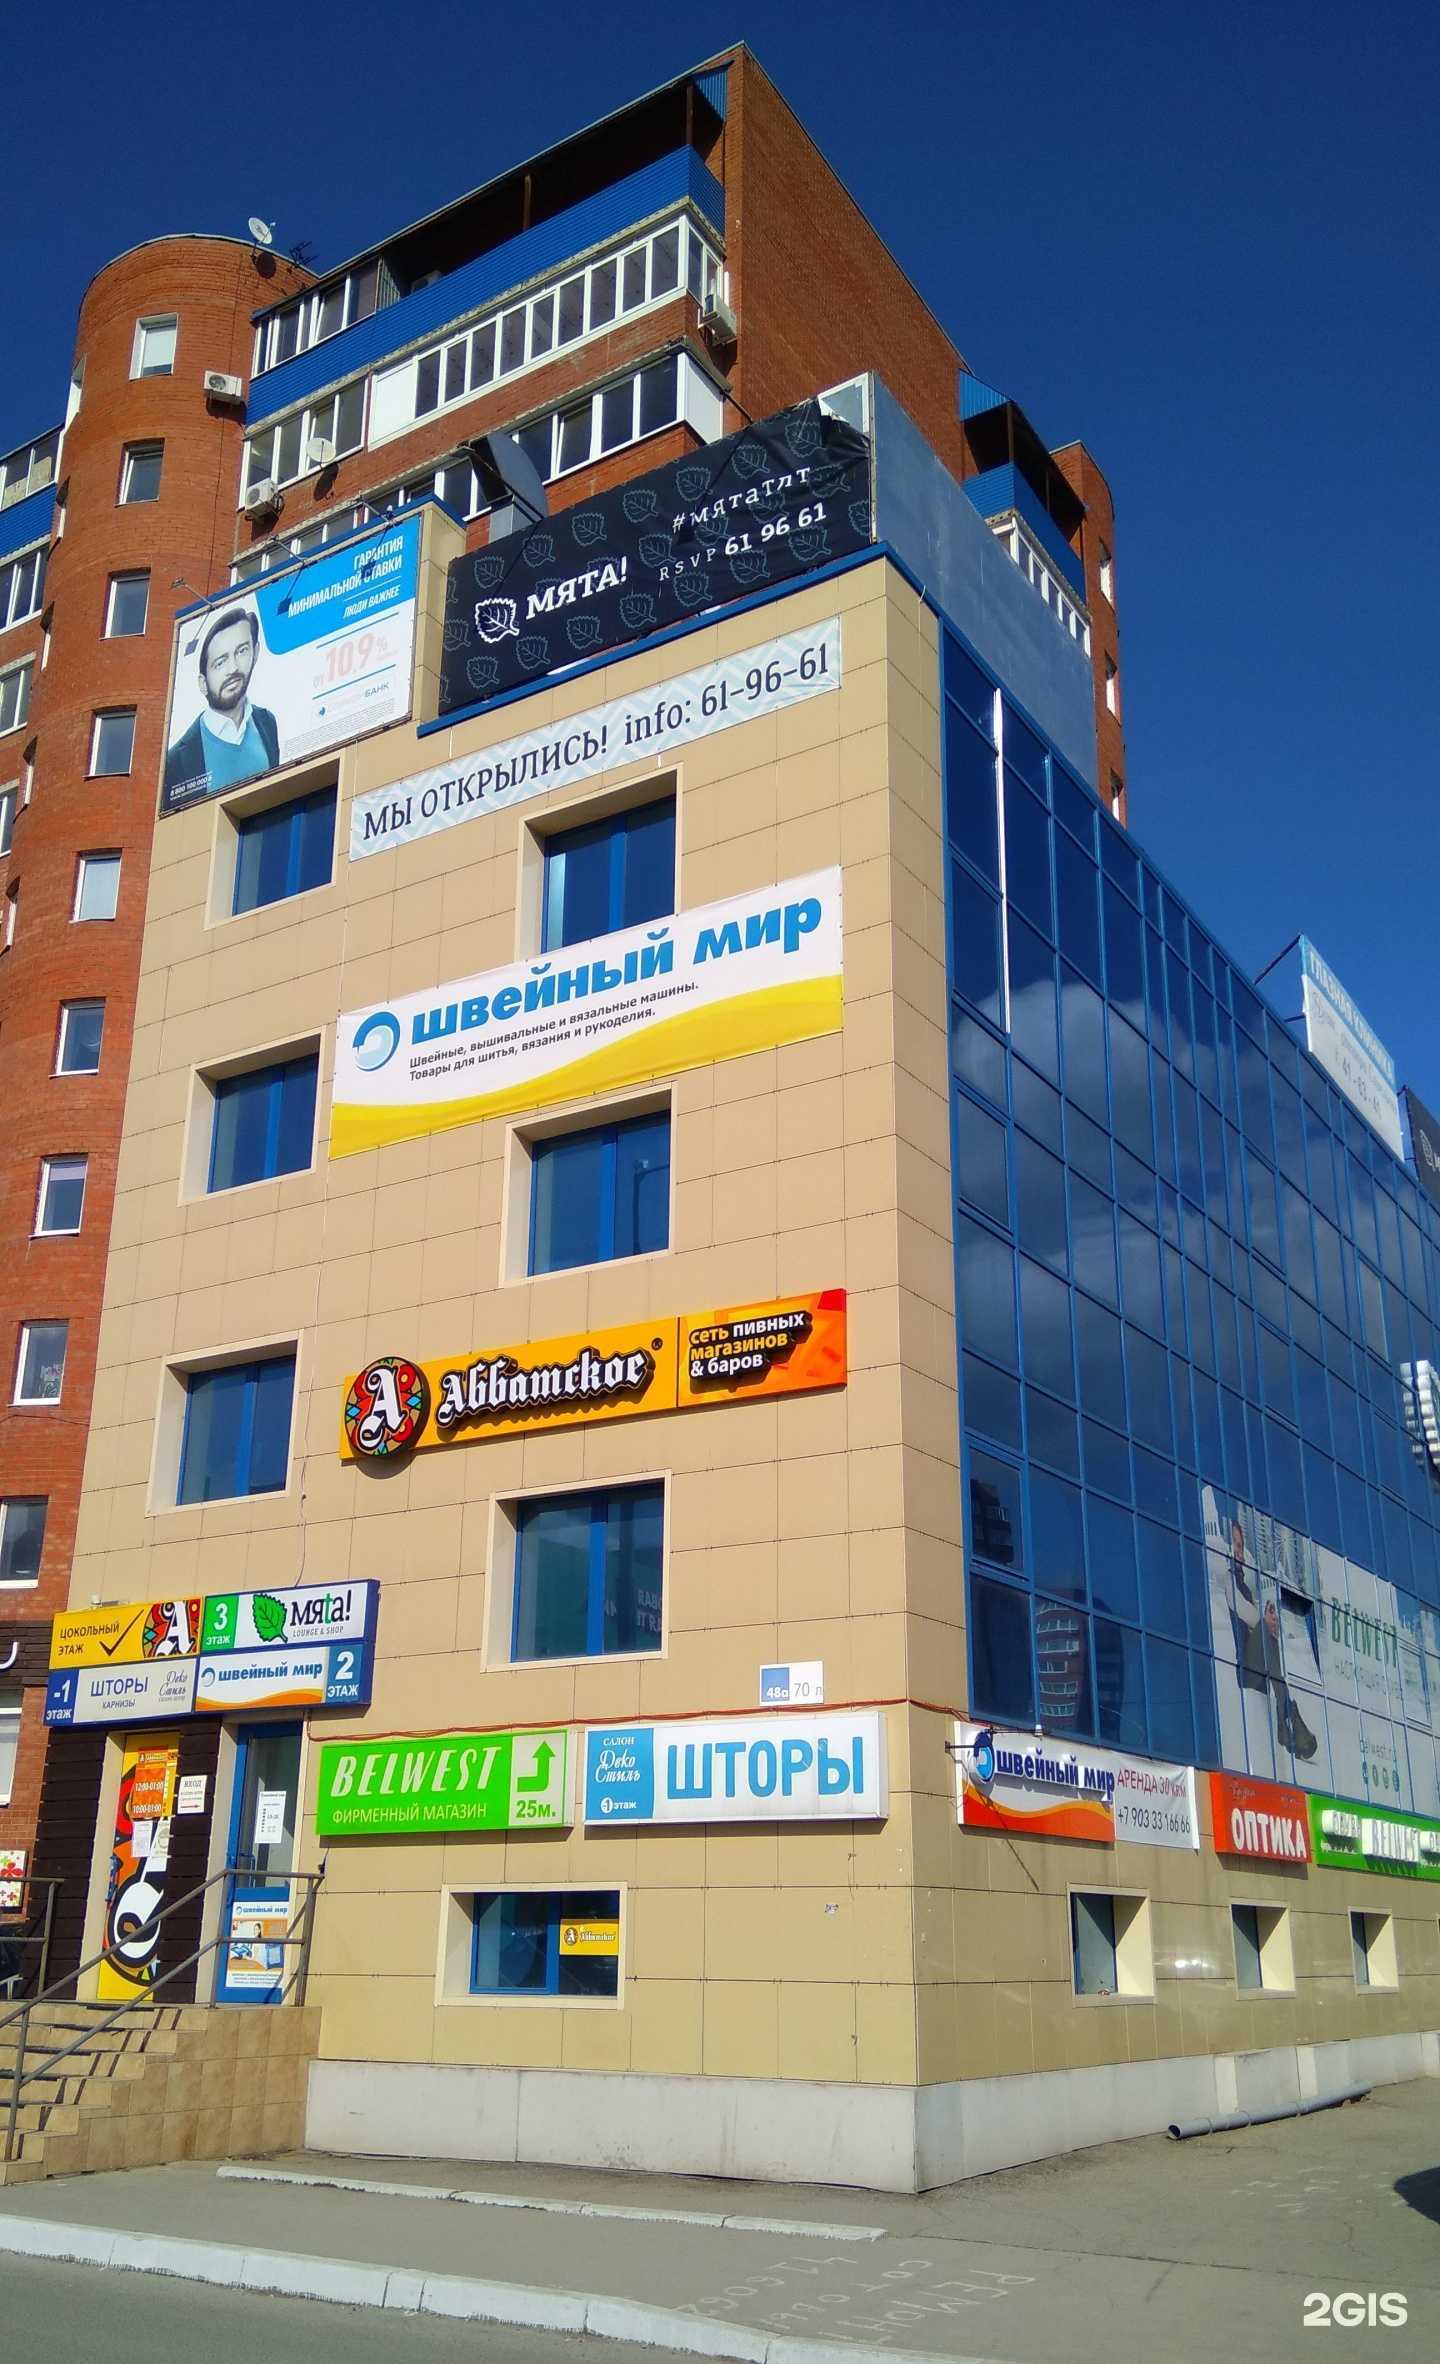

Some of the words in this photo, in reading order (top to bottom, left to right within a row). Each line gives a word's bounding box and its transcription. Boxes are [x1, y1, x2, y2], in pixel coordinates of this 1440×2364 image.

[725, 532, 752, 556] 61
[760, 516, 790, 543] 96
[798, 501, 827, 528] 61
[354, 535, 404, 570] ГАРАНТИЯ
[288, 570, 362, 618] МИНИМАЛЬНОЙ
[364, 554, 402, 583] СТАВКИ
[368, 584, 401, 609] ВАЖНЕЕ
[525, 555, 628, 621] МЯТА!
[364, 681, 390, 697] БАНК
[362, 796, 412, 841] МЫ
[420, 725, 608, 819] ОТКРЫЛИСЬ!
[624, 698, 691, 745] info:
[700, 642, 828, 718] 61-96-61
[411, 926, 674, 1046] швейный
[693, 896, 822, 965] мир
[409, 1045, 467, 1069] Швейные,
[470, 1020, 556, 1052] вышивальные
[559, 1018, 566, 1027] и
[569, 998, 637, 1024] вязальные
[640, 982, 699, 1004] машины.
[410, 1062, 451, 1081] Товары
[453, 1056, 475, 1071] для
[478, 1045, 518, 1063] шитья,
[521, 1030, 571, 1052] вязания
[574, 1028, 581, 1037] и
[585, 1008, 656, 1037] рукоделия.
[690, 1328, 729, 1344] сеть
[733, 1313, 804, 1338] пивных
[690, 1333, 788, 1361] магазинов
[690, 1360, 704, 1377] &
[707, 1354, 763, 1375] баров
[60, 1621, 120, 1639] ЦОКОЛЬНЫЙ
[214, 1603, 228, 1630] 3
[206, 1635, 230, 1645] этаж
[293, 1628, 319, 1638] LOUNGE
[326, 1626, 344, 1635] SHOP
[58, 1643, 84, 1656] ЭТАЖ
[218, 1661, 288, 1682] швейный
[292, 1663, 323, 1679] мир
[335, 1651, 354, 1680] 2
[54, 1679, 71, 1703] -1
[90, 1676, 149, 1697] ШТОРЫ
[327, 1683, 360, 1697] ЭТАЖ
[794, 1682, 810, 1697] 70
[46, 1708, 72, 1720] этаж
[102, 1699, 136, 1709] КАРНИЗЫ
[330, 1746, 502, 1798] BELWEST
[667, 1736, 864, 1800] ШТОРЫ
[996, 1747, 1079, 1786] швейный
[1084, 1766, 1115, 1804] мир
[1117, 1769, 1157, 1796] АРЕНДА
[332, 1803, 420, 1824] ФИРМЕННЫЙ
[423, 1803, 487, 1821] МАГАЗИН
[516, 1799, 556, 1819] 25м.
[613, 1801, 637, 1810] этаж
[1118, 1806, 1129, 1824] +7
[1131, 1807, 1149, 1828] 903
[1152, 1810, 1163, 1830] 33
[1165, 1813, 1179, 1832] 166
[1180, 1815, 1191, 1834] 66
[1231, 1807, 1307, 1859] ОПТИКА
